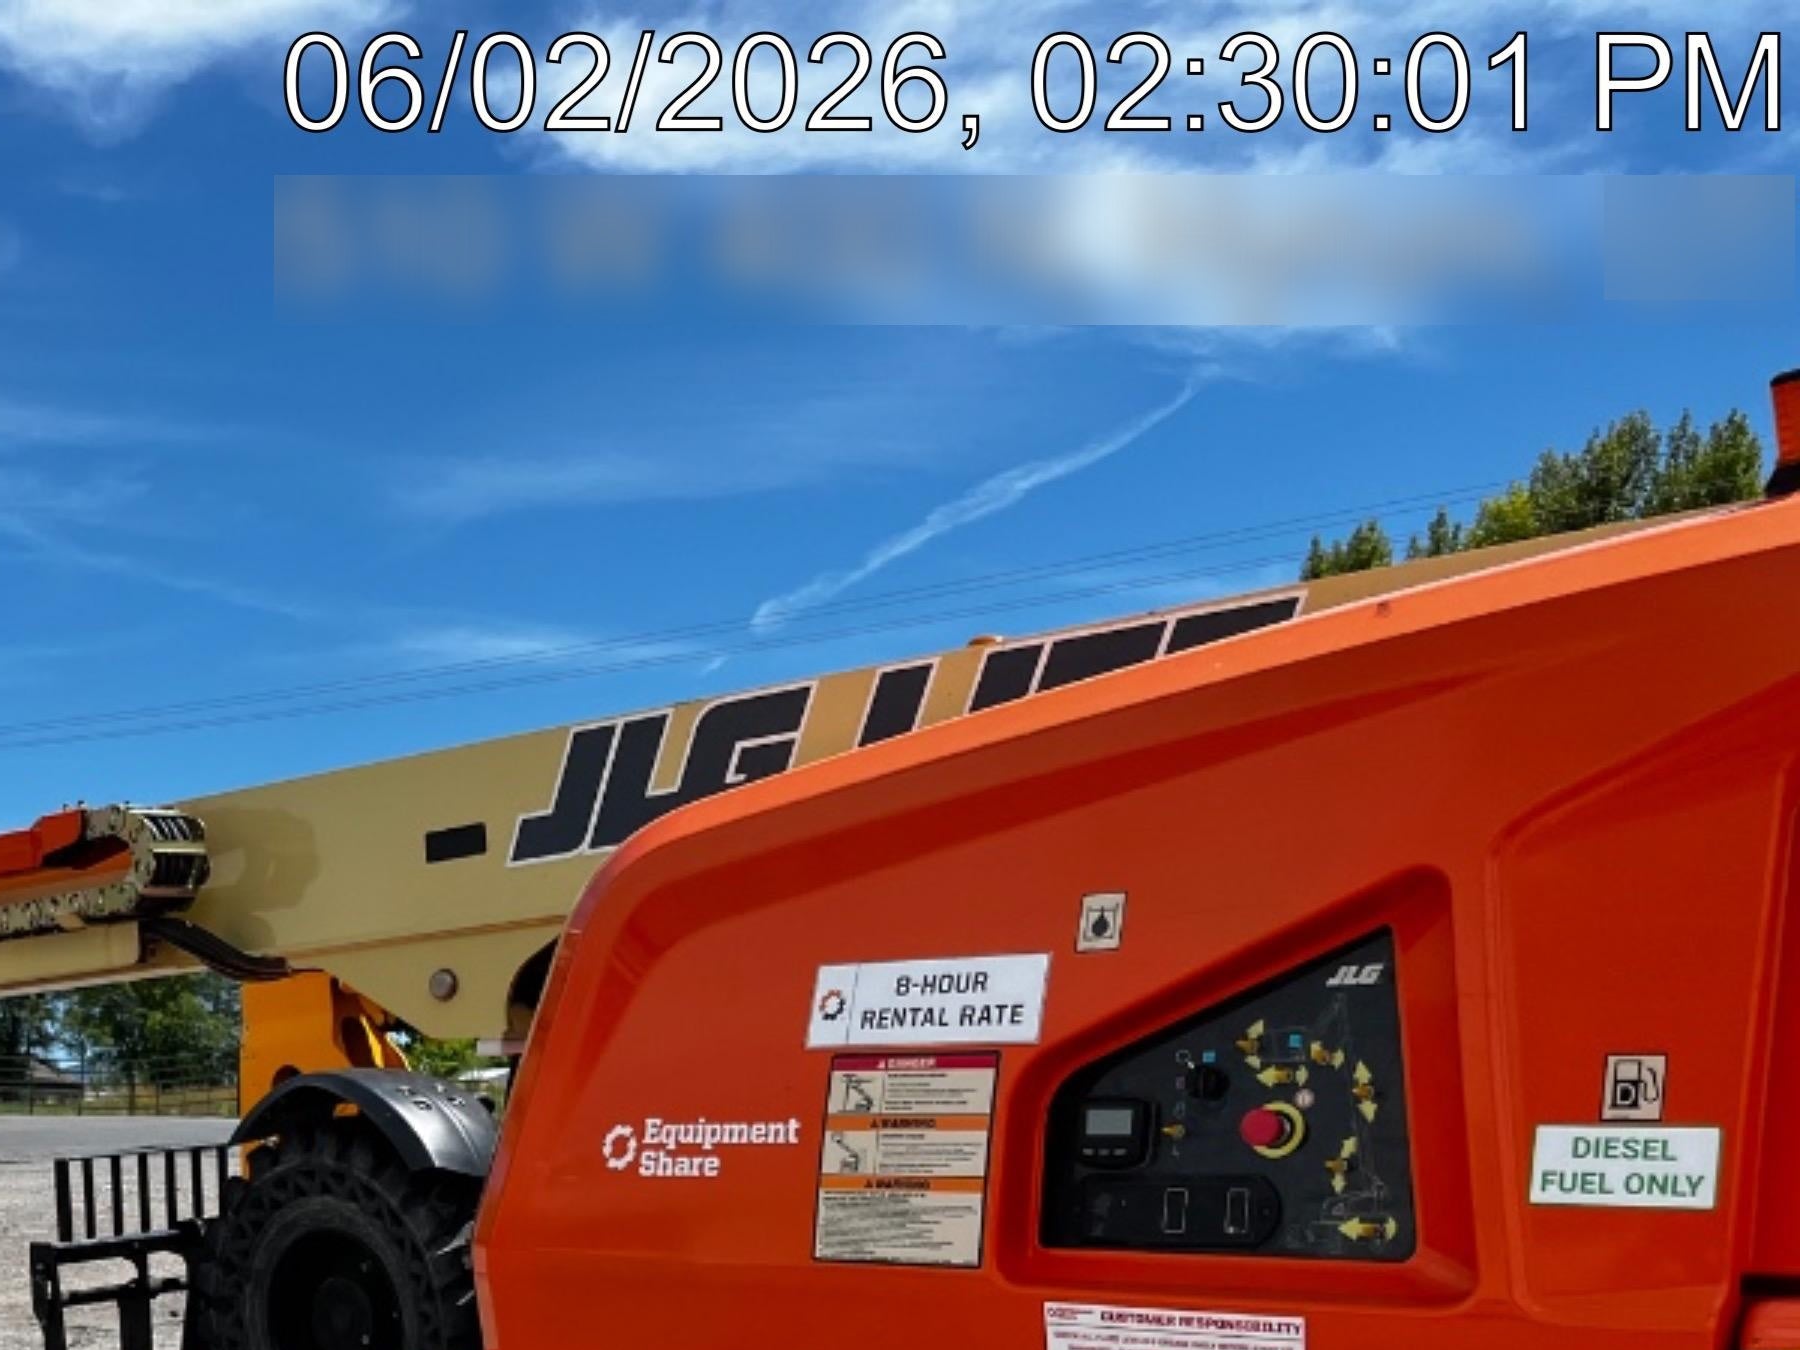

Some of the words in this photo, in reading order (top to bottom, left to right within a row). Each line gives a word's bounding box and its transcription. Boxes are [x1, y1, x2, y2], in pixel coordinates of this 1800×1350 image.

[506, 680, 819, 867] JLG
[895, 971, 988, 997] 8-HOUR
[1325, 963, 1384, 988] JLG
[860, 1006, 949, 1031] RENTAL
[959, 1003, 1025, 1028] RATE
[642, 1117, 800, 1150] Equipment
[1571, 1136, 1677, 1161] DIESEL
[638, 1150, 720, 1177] Share
[1540, 1170, 1615, 1195] FUEL
[1623, 1173, 1705, 1197] ONLY
[1100, 1309, 1177, 1328] CUSTOMER
[1178, 1313, 1301, 1336] RESPONSIBILITY
